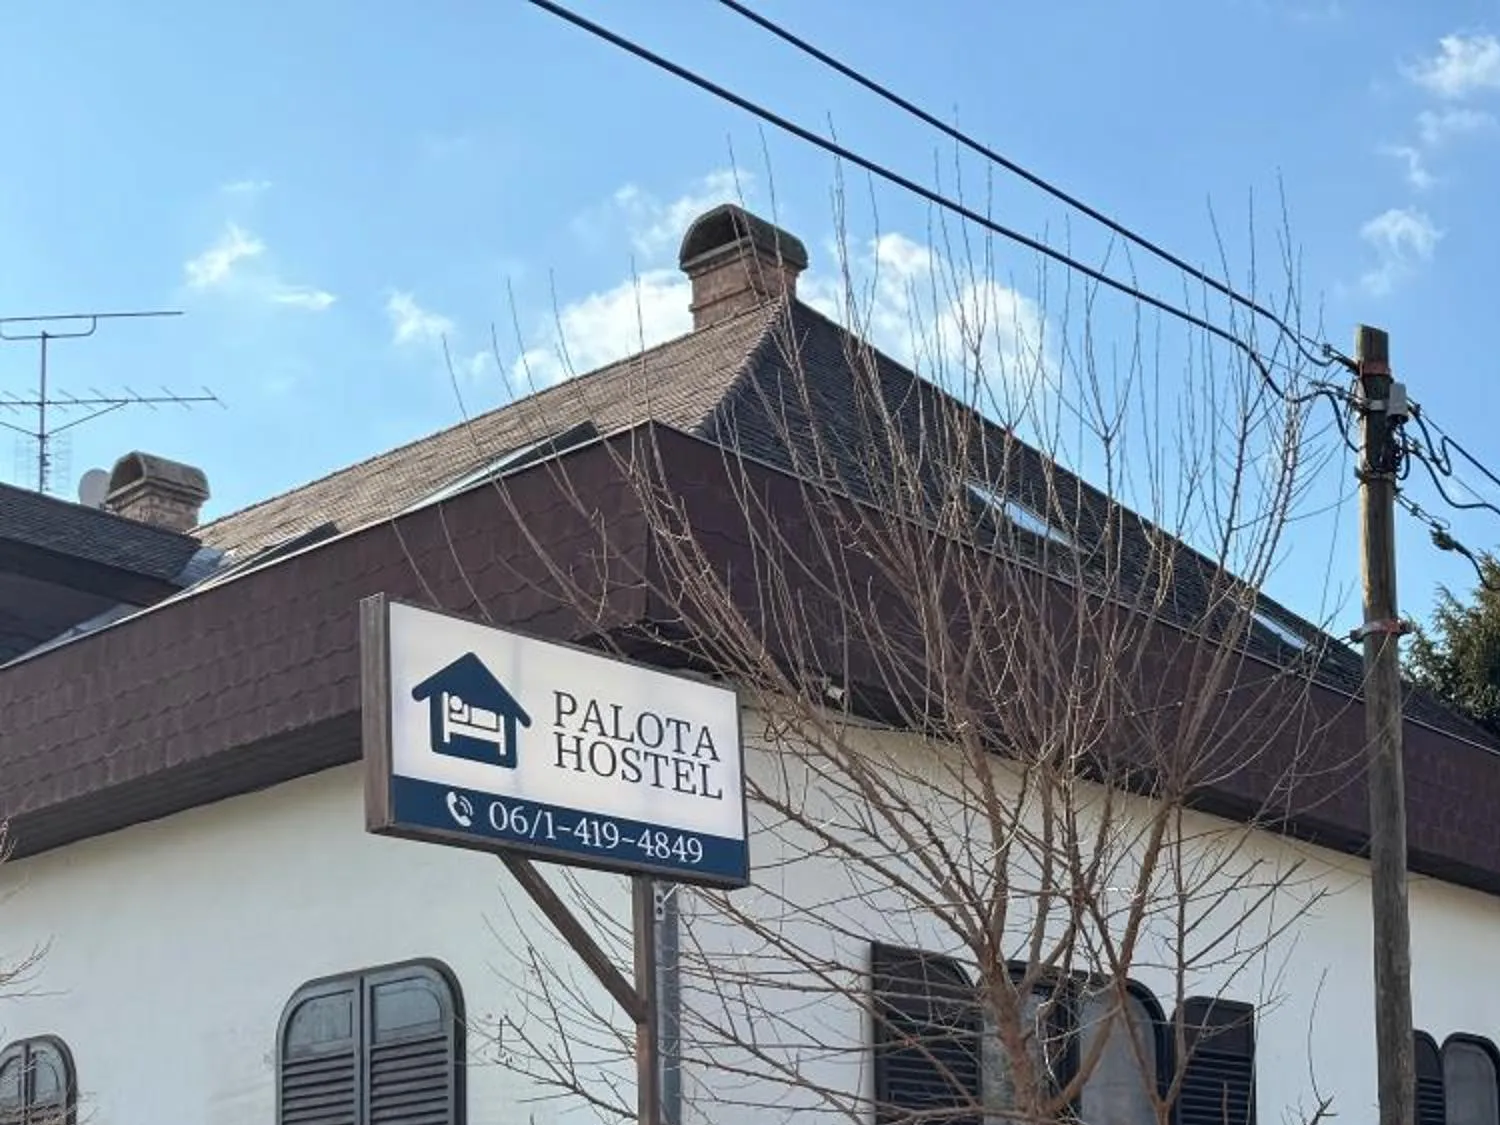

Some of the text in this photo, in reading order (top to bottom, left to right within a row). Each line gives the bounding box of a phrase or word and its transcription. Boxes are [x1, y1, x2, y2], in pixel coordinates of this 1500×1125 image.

[553, 690, 721, 762] PALOTA
[553, 731, 723, 800] HOSTEL
[488, 801, 704, 864] 06/1-419-4849
